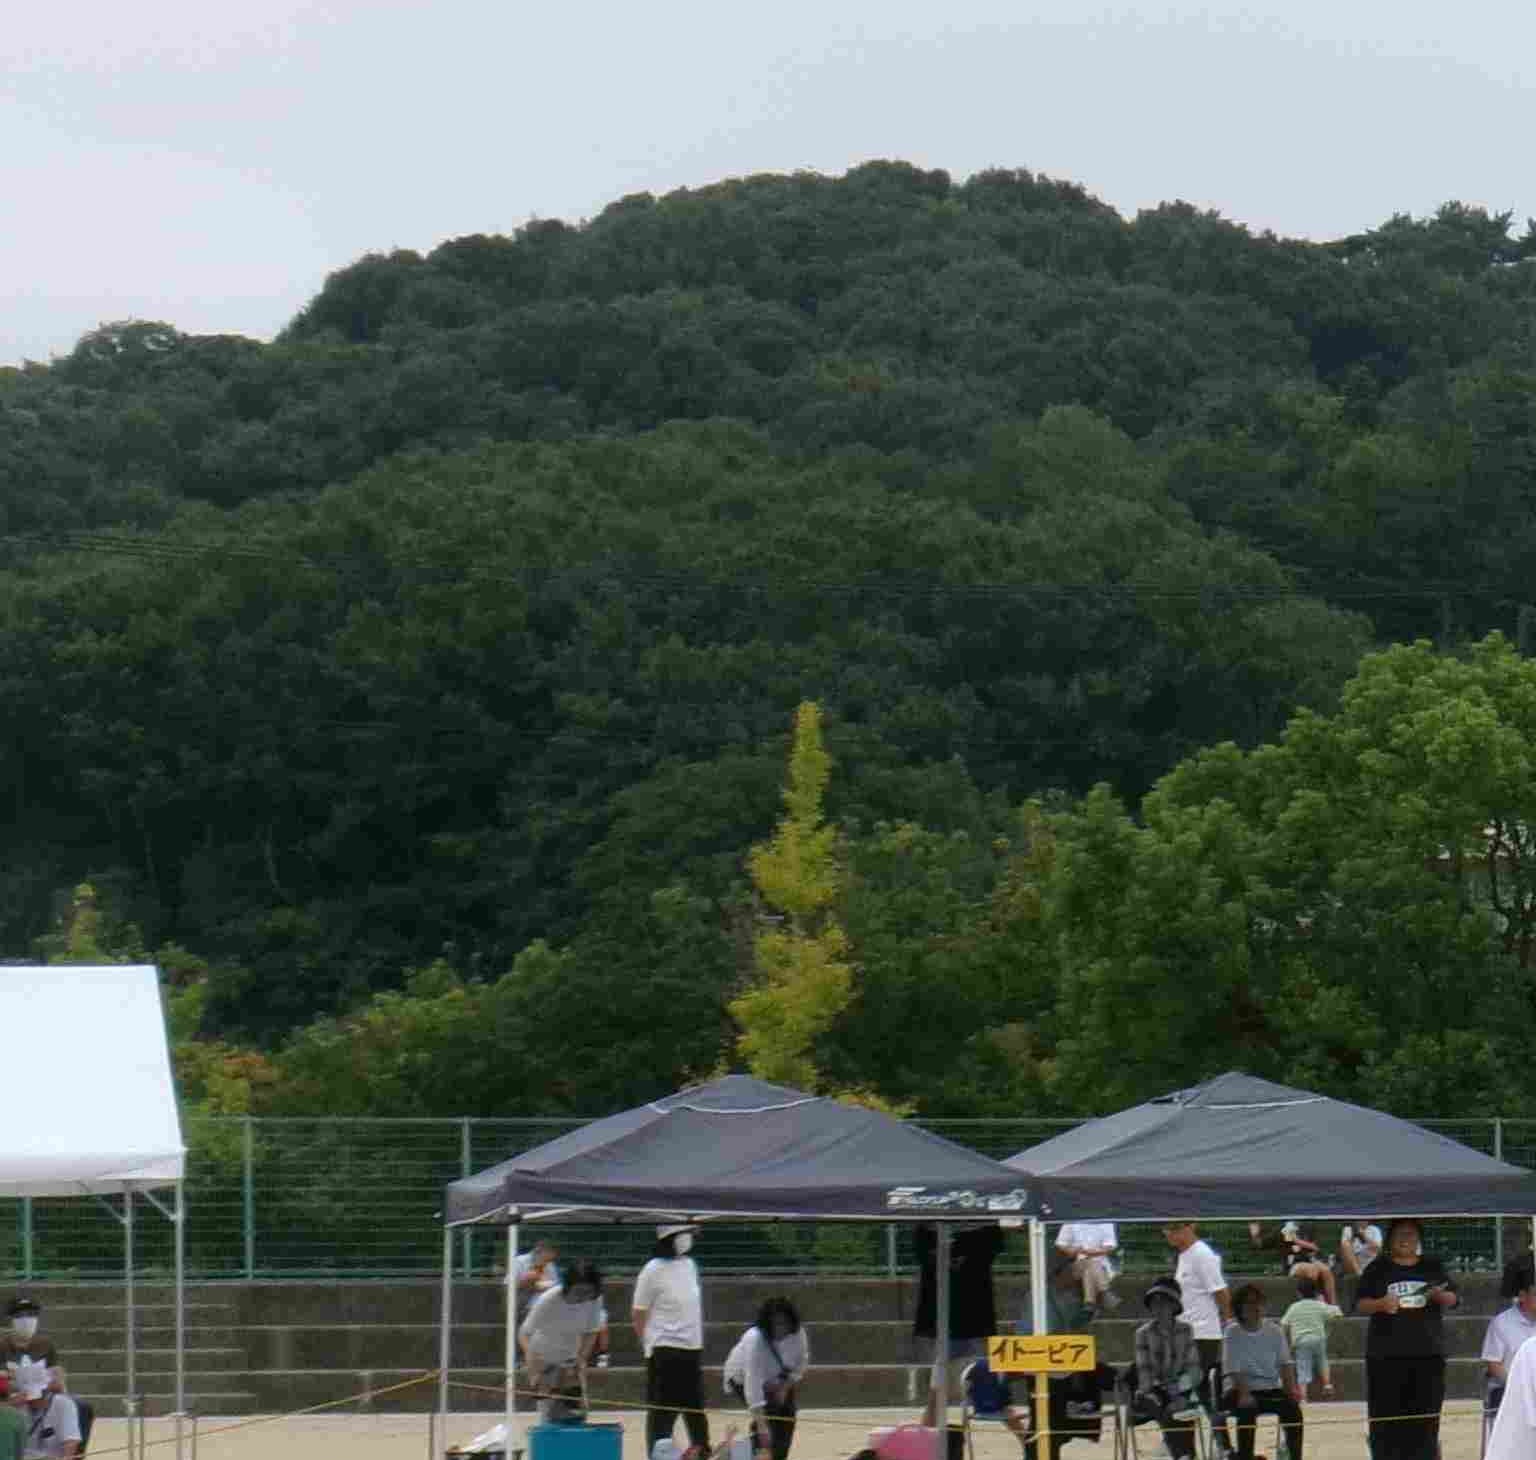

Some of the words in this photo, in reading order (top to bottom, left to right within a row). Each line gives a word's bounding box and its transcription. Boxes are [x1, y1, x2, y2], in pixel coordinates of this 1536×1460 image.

[992, 1339, 1090, 1365] イトーピア
